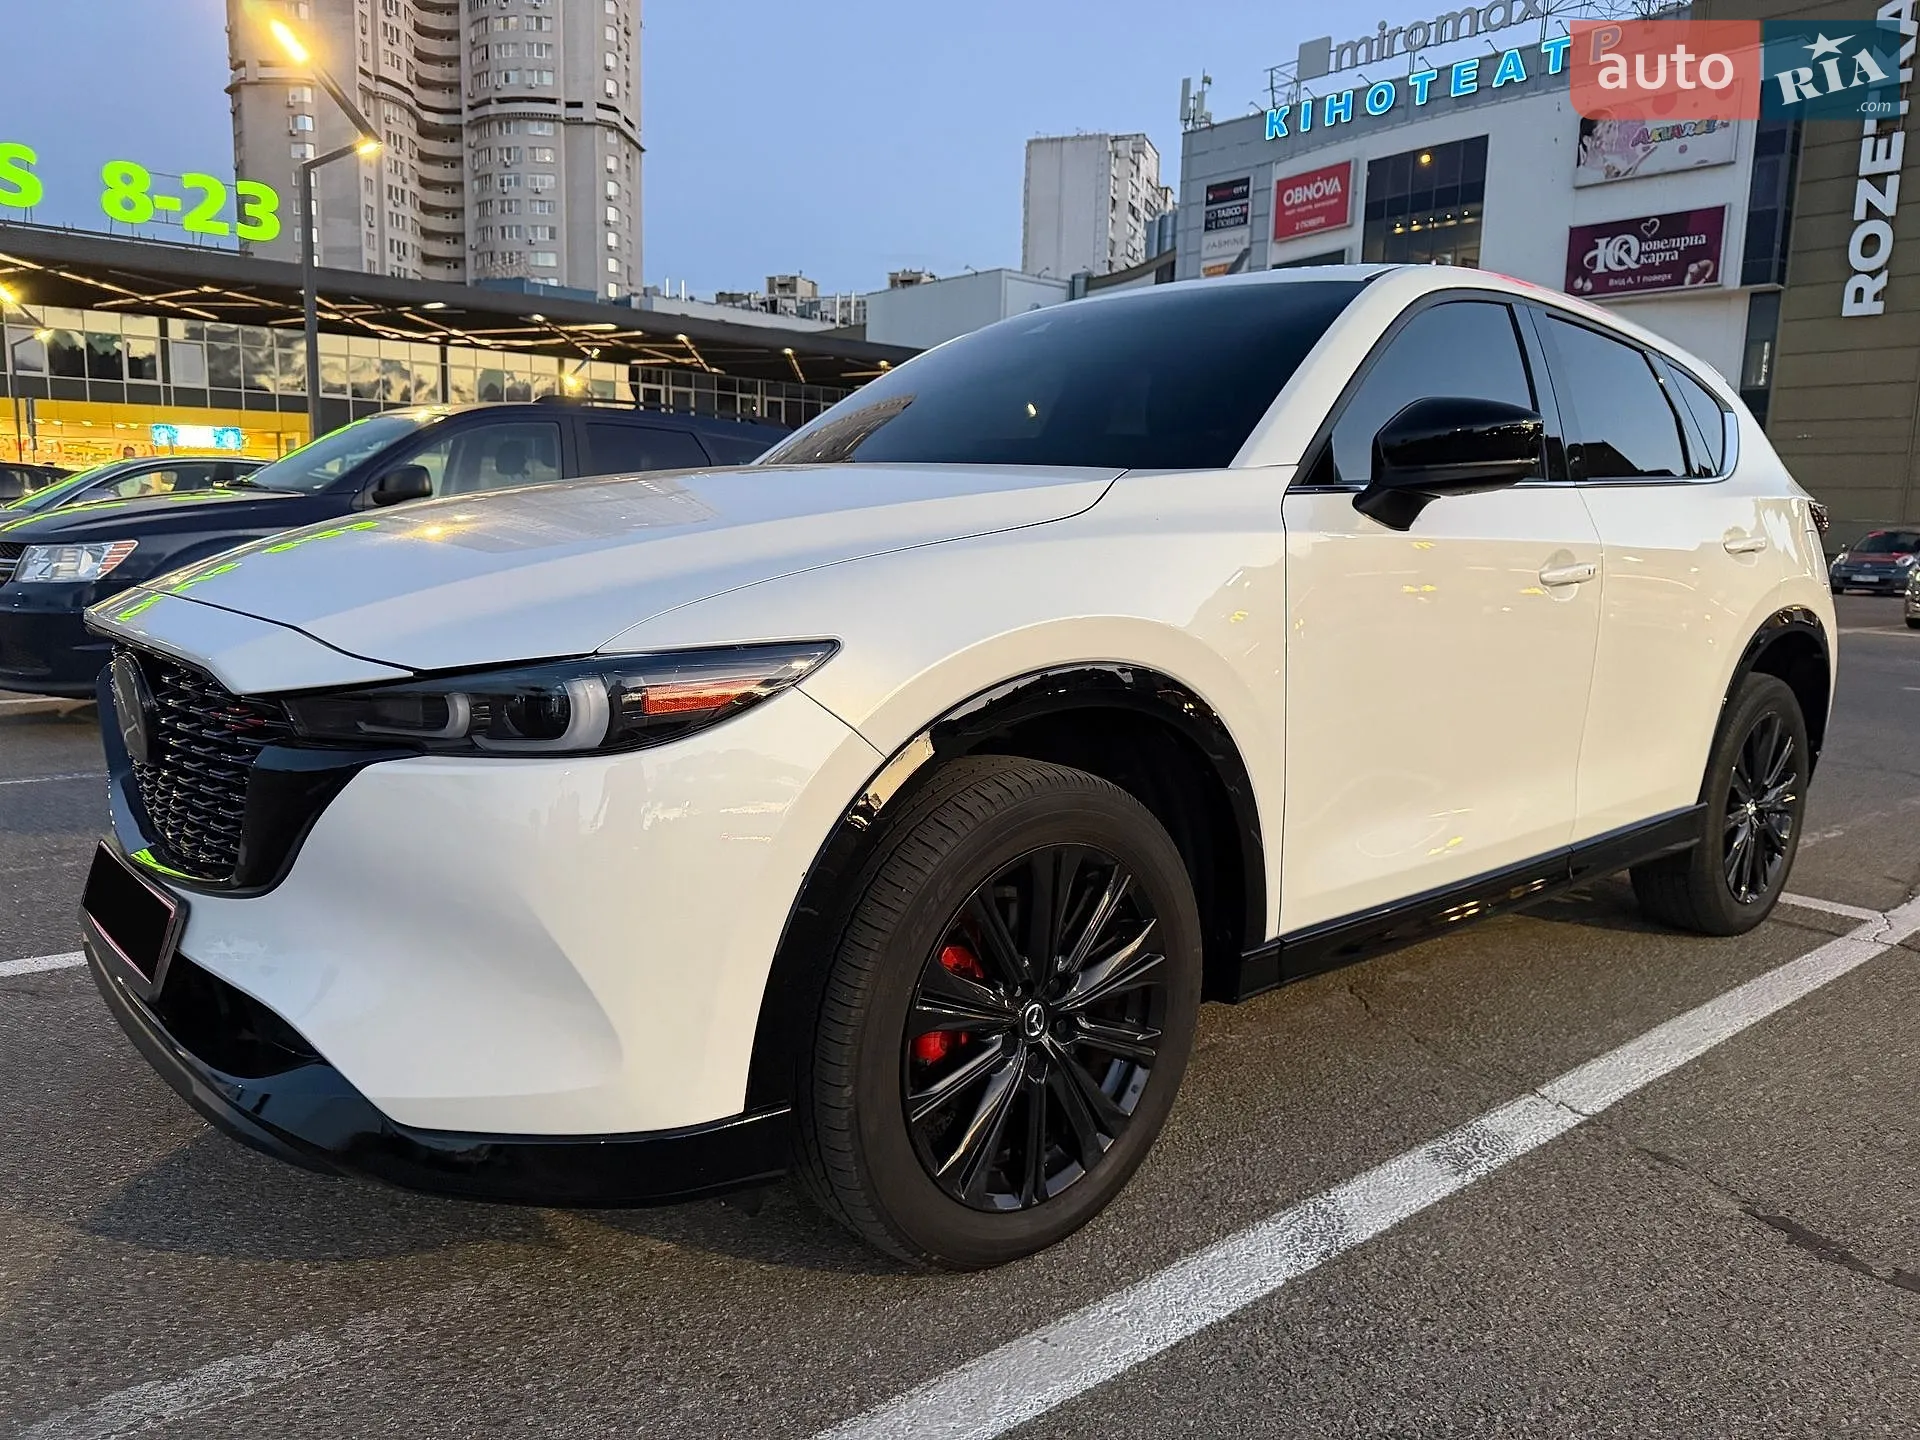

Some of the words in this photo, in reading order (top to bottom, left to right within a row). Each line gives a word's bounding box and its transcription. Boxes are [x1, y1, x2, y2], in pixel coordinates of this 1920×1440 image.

[1335, 0, 1544, 73] miromax
[101, 160, 281, 242] 8-23
[1639, 249, 1679, 266] карта
